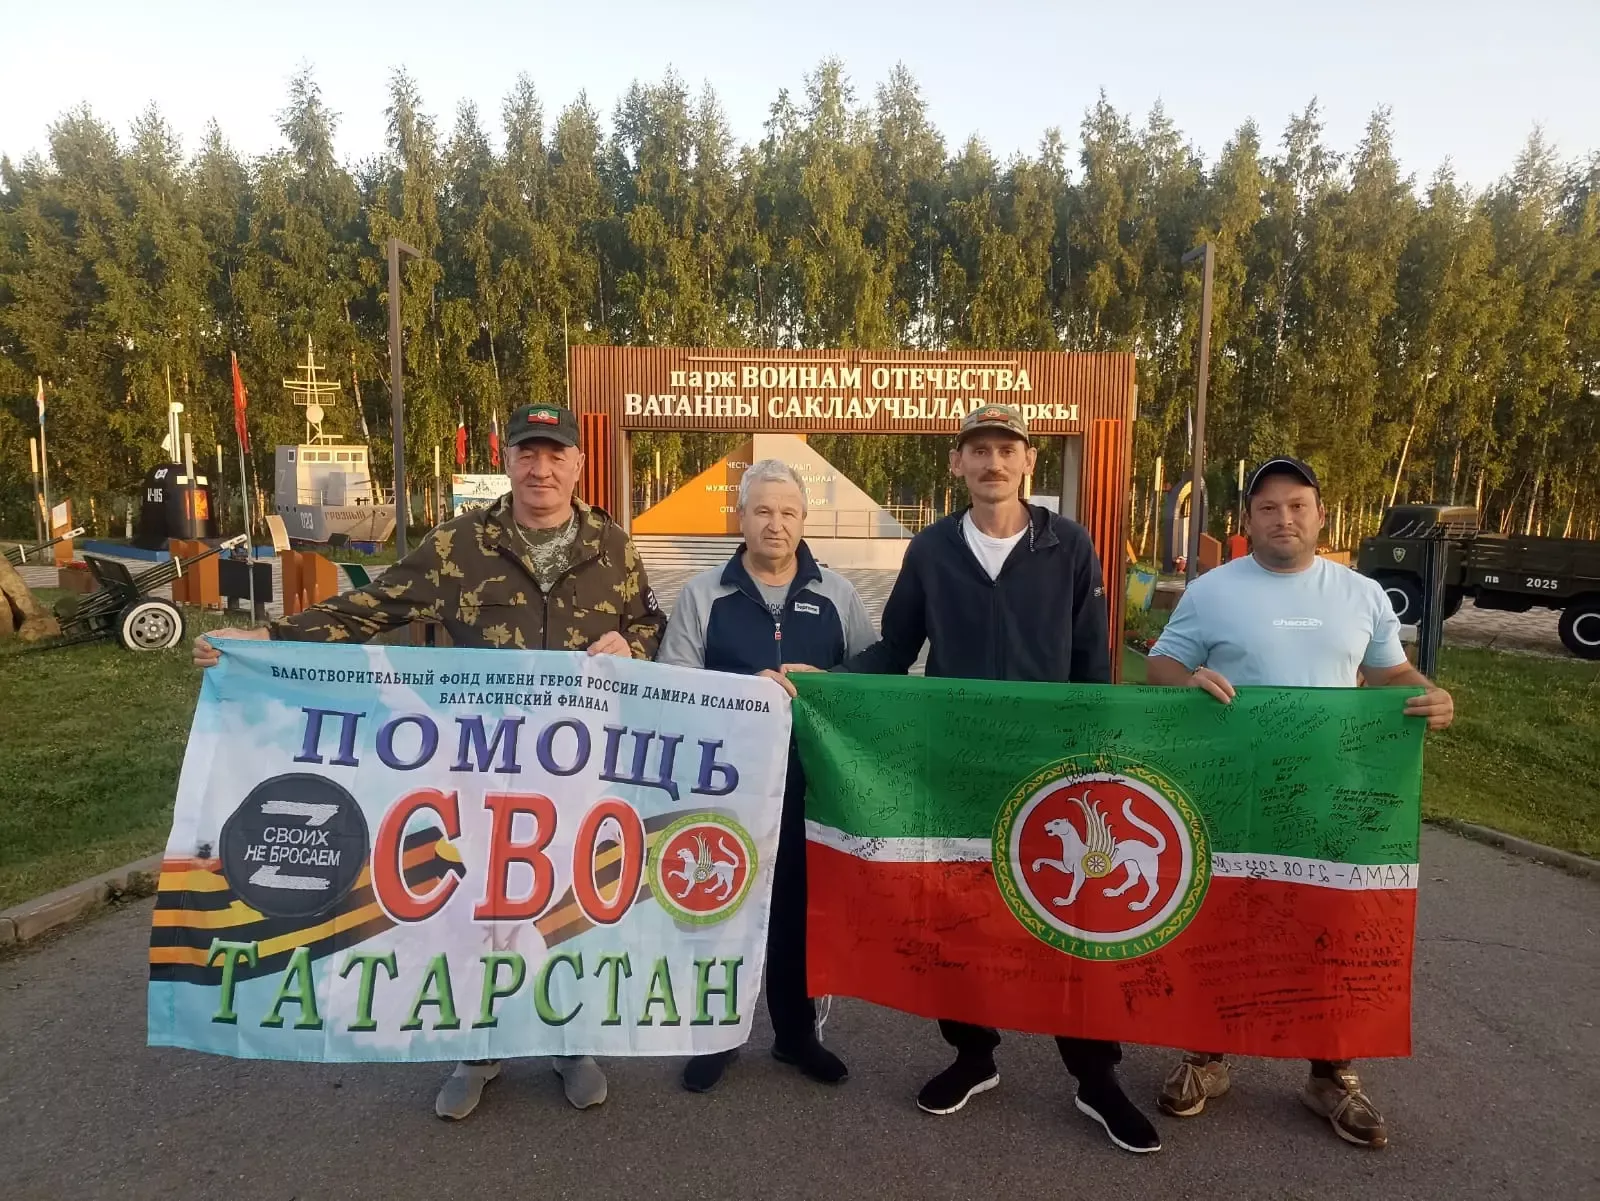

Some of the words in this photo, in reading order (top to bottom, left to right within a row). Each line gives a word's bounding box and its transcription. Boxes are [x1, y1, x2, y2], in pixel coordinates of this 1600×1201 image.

[670, 370, 737, 392] парк
[742, 366, 861, 389] ВОИНАМ
[871, 367, 1032, 391] ОТЕЧЕСТВА
[624, 393, 760, 417] ВАТАННЫ
[705, 484, 742, 493] МУЖЕСТ
[1526, 577, 1558, 590] 2025
[270, 666, 434, 685] БЛАГОТВОРИТЕЛЬНЫЙ
[440, 672, 480, 686] ФОНД
[486, 672, 534, 686] ИМЕНИ
[540, 674, 582, 688] ГЕРОЯ
[587, 676, 639, 696] РОССИИ
[642, 686, 696, 705] ДАМИРА
[701, 694, 770, 713] ИСЛАМОВА
[439, 690, 551, 706] БАЛТАСИНСКИЙ
[557, 694, 609, 712] ФИЛИАЛ
[293, 706, 740, 801] ПОМОЩЬ
[263, 827, 330, 846] СВОИХ
[244, 844, 267, 861] НЕ
[269, 845, 341, 867] БРОСАЕМ
[372, 787, 647, 925] СВО
[1047, 929, 1156, 958] ТАТАРСТАН
[208, 938, 744, 1032] ТАТАРСТАН
